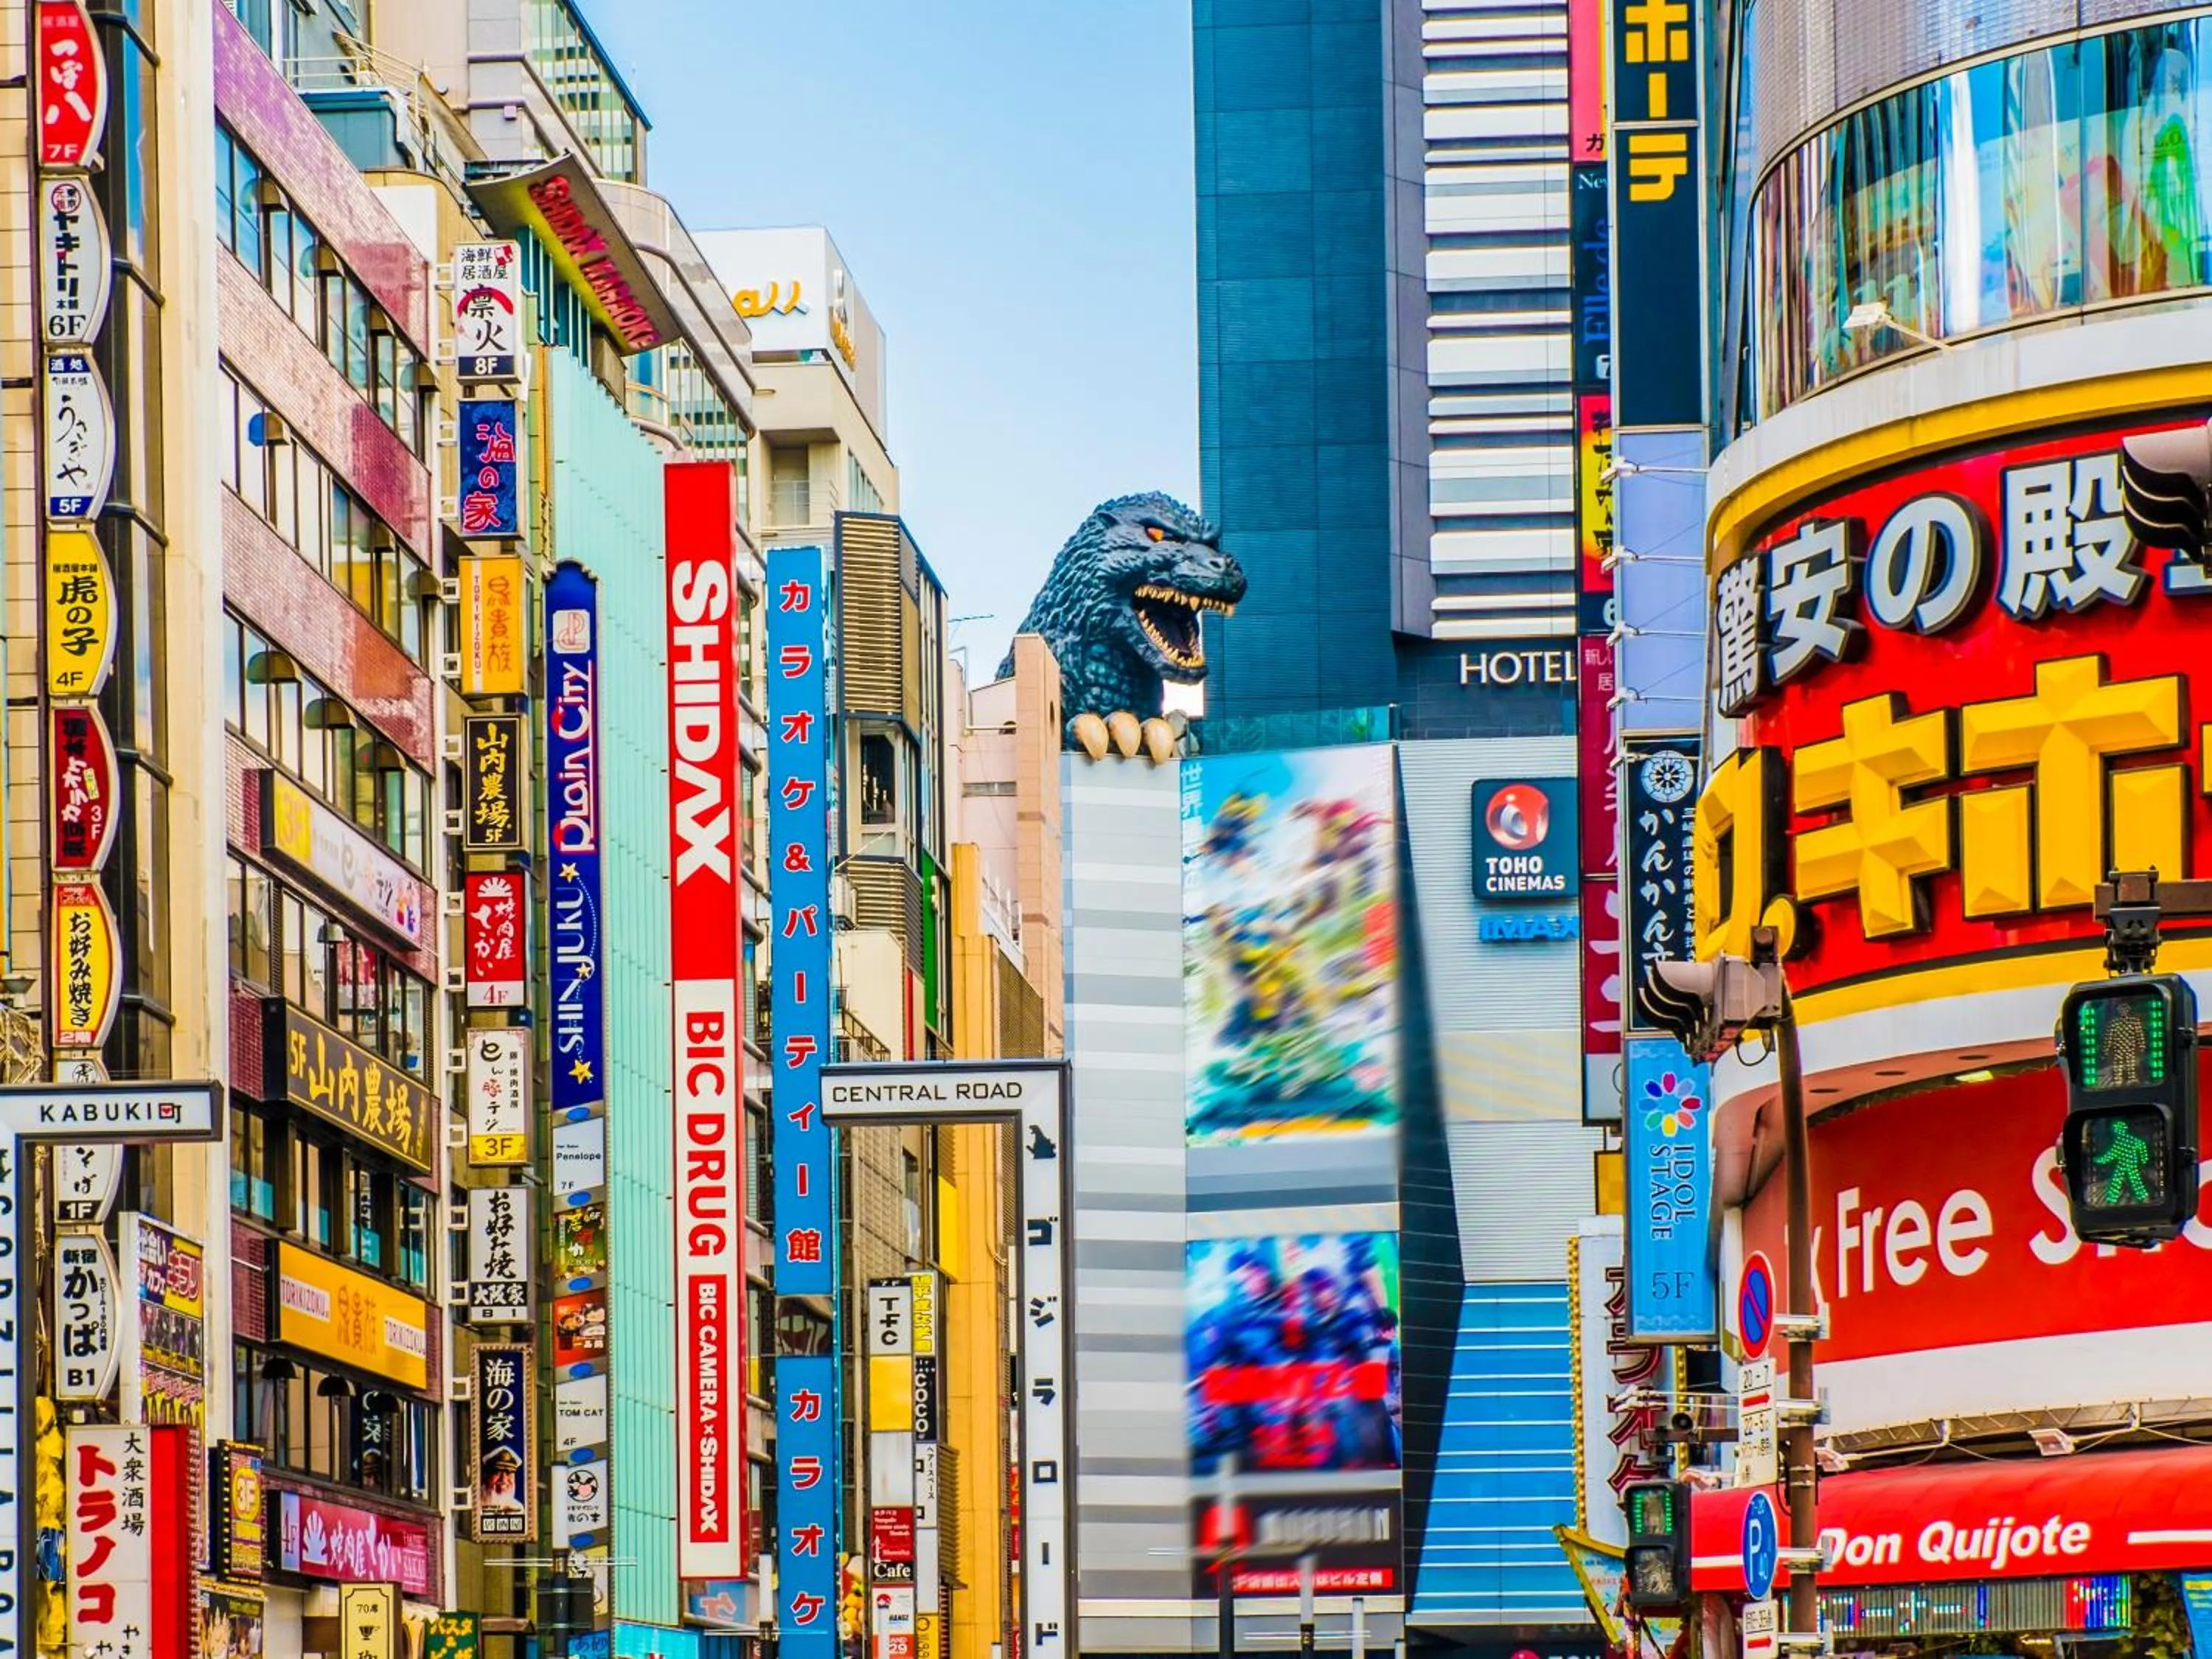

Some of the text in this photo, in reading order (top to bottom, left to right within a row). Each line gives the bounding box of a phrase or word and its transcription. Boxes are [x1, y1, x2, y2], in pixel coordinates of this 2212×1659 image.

[46, 144, 79, 159] 7F
[53, 211, 80, 297] ヤキトリ
[461, 248, 493, 263] 海鮮
[461, 265, 509, 280] 居酒屋
[49, 315, 86, 336] 6F
[474, 357, 498, 375] 8F
[58, 499, 83, 512] 5F
[1715, 451, 2212, 716] 驚安の殿
[56, 575, 100, 657] 虎の子
[55, 672, 83, 686] 4F
[1459, 650, 1578, 684] HOTEL
[672, 560, 731, 887] SHIDAX
[476, 722, 510, 828] 山内農場
[91, 805, 102, 840] 3F
[484, 829, 503, 844] 5F
[1486, 856, 1543, 875] TOHO
[1486, 875, 1565, 892] CINEMAS
[1478, 913, 1579, 942] IMAX
[68, 911, 93, 1028] お好み焼き
[557, 886, 596, 1054] SHINJUKU
[482, 984, 509, 1004] 4F
[290, 1029, 307, 1079] 5F
[308, 1032, 412, 1154] 山内農場
[832, 1082, 1023, 1102] CENTRAL ROAD
[484, 1138, 512, 1157] 3F
[684, 1011, 727, 1257] BIC DRUG
[556, 1152, 602, 1161] Penelope
[1649, 1144, 1673, 1240] STAGE
[1673, 1144, 1695, 1223] IDOL
[65, 1201, 92, 1219] 1F
[63, 1249, 97, 1264] 新宿
[1836, 1186, 1994, 1298] Free
[698, 1284, 717, 1319] BIC
[1651, 1271, 1694, 1301] 5F
[63, 1266, 99, 1357] かっぱ
[67, 1368, 95, 1386] B1
[485, 1357, 515, 1442] 海の家
[559, 1408, 605, 1417] TOM CAT
[563, 1438, 578, 1447] 4F
[1027, 1216, 1059, 1646] ゴジラロード
[121, 1431, 146, 1537] 大衆酒場
[790, 1388, 827, 1627] カラオケ
[76, 1444, 117, 1624] トラノコ
[1749, 1518, 1762, 1584] P
[1817, 1514, 2091, 1572] Don Quijote
[874, 1562, 911, 1578] Cafe
